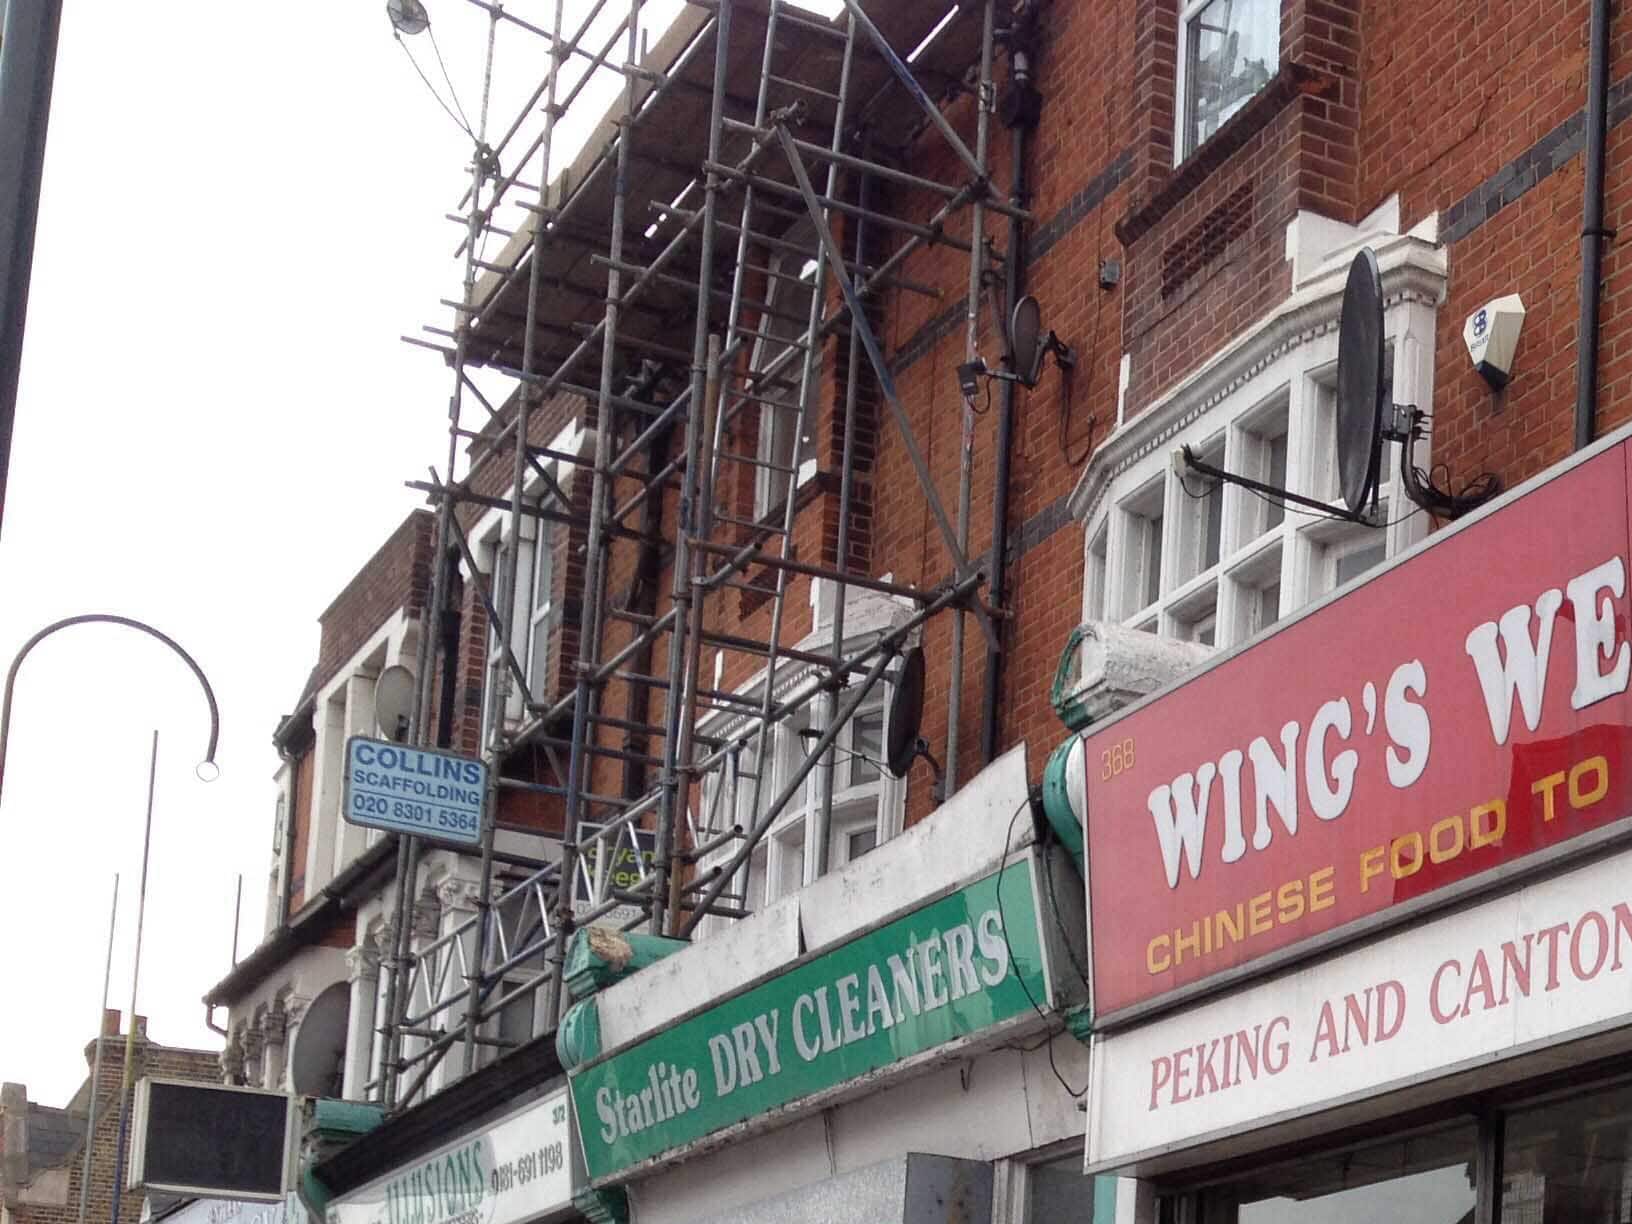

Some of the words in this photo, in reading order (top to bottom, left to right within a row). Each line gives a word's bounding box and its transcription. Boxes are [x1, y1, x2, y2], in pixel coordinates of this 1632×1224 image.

[354, 770, 480, 806] SCAFFOLDING
[355, 744, 480, 785] COLLINS
[1101, 737, 1136, 781] 368
[1147, 658, 1431, 889] WING'S
[353, 794, 388, 814] 020
[393, 803, 432, 823] 8301
[438, 810, 477, 831] 5364
[1146, 866, 1337, 975] CHINESE
[1359, 799, 1507, 893] FOOD
[1532, 755, 1609, 822] TO
[596, 1061, 700, 1145] Starlite
[708, 1008, 781, 1098] DRY
[793, 909, 1009, 1062] CLEANERS
[1148, 1016, 1290, 1111] PEKING
[1309, 980, 1406, 1062] AND
